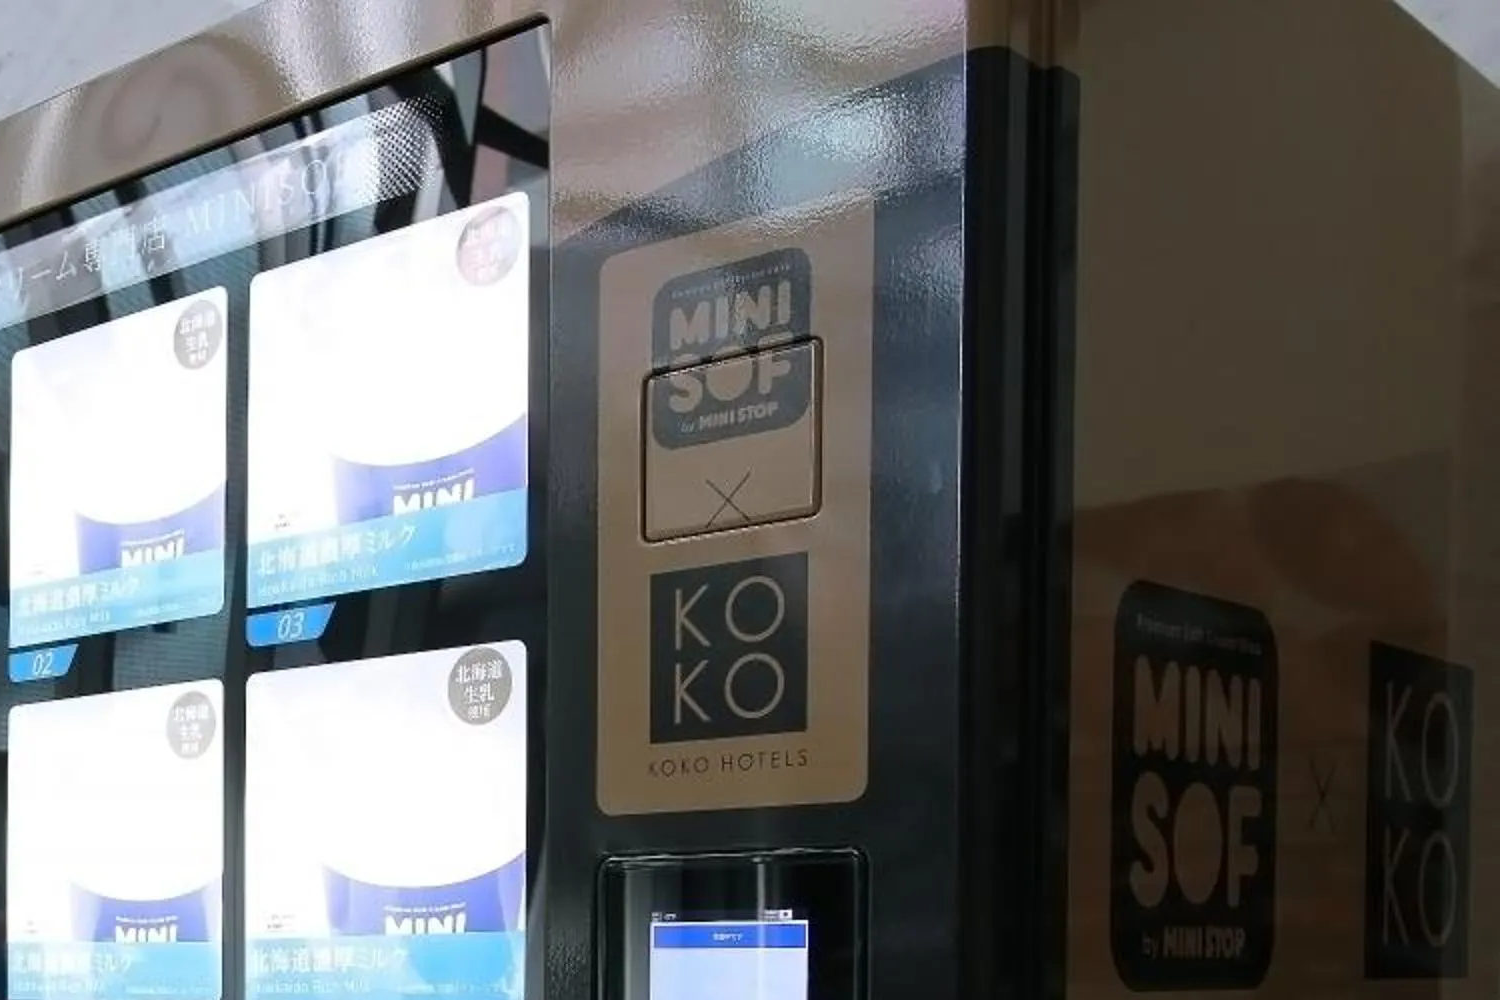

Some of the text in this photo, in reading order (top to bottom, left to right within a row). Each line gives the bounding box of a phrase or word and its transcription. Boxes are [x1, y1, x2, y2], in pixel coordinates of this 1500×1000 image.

[669, 279, 792, 350] MINI
[668, 330, 794, 413] SOF
[277, 611, 306, 641] 03
[674, 575, 786, 650] KO
[32, 652, 54, 677] 02
[673, 652, 786, 725] KO
[1133, 653, 1262, 772] MINI
[1384, 679, 1460, 808] KO
[649, 748, 808, 778] KOKO HOTELS
[1129, 771, 1263, 910] SOF
[1380, 822, 1457, 949] KO
